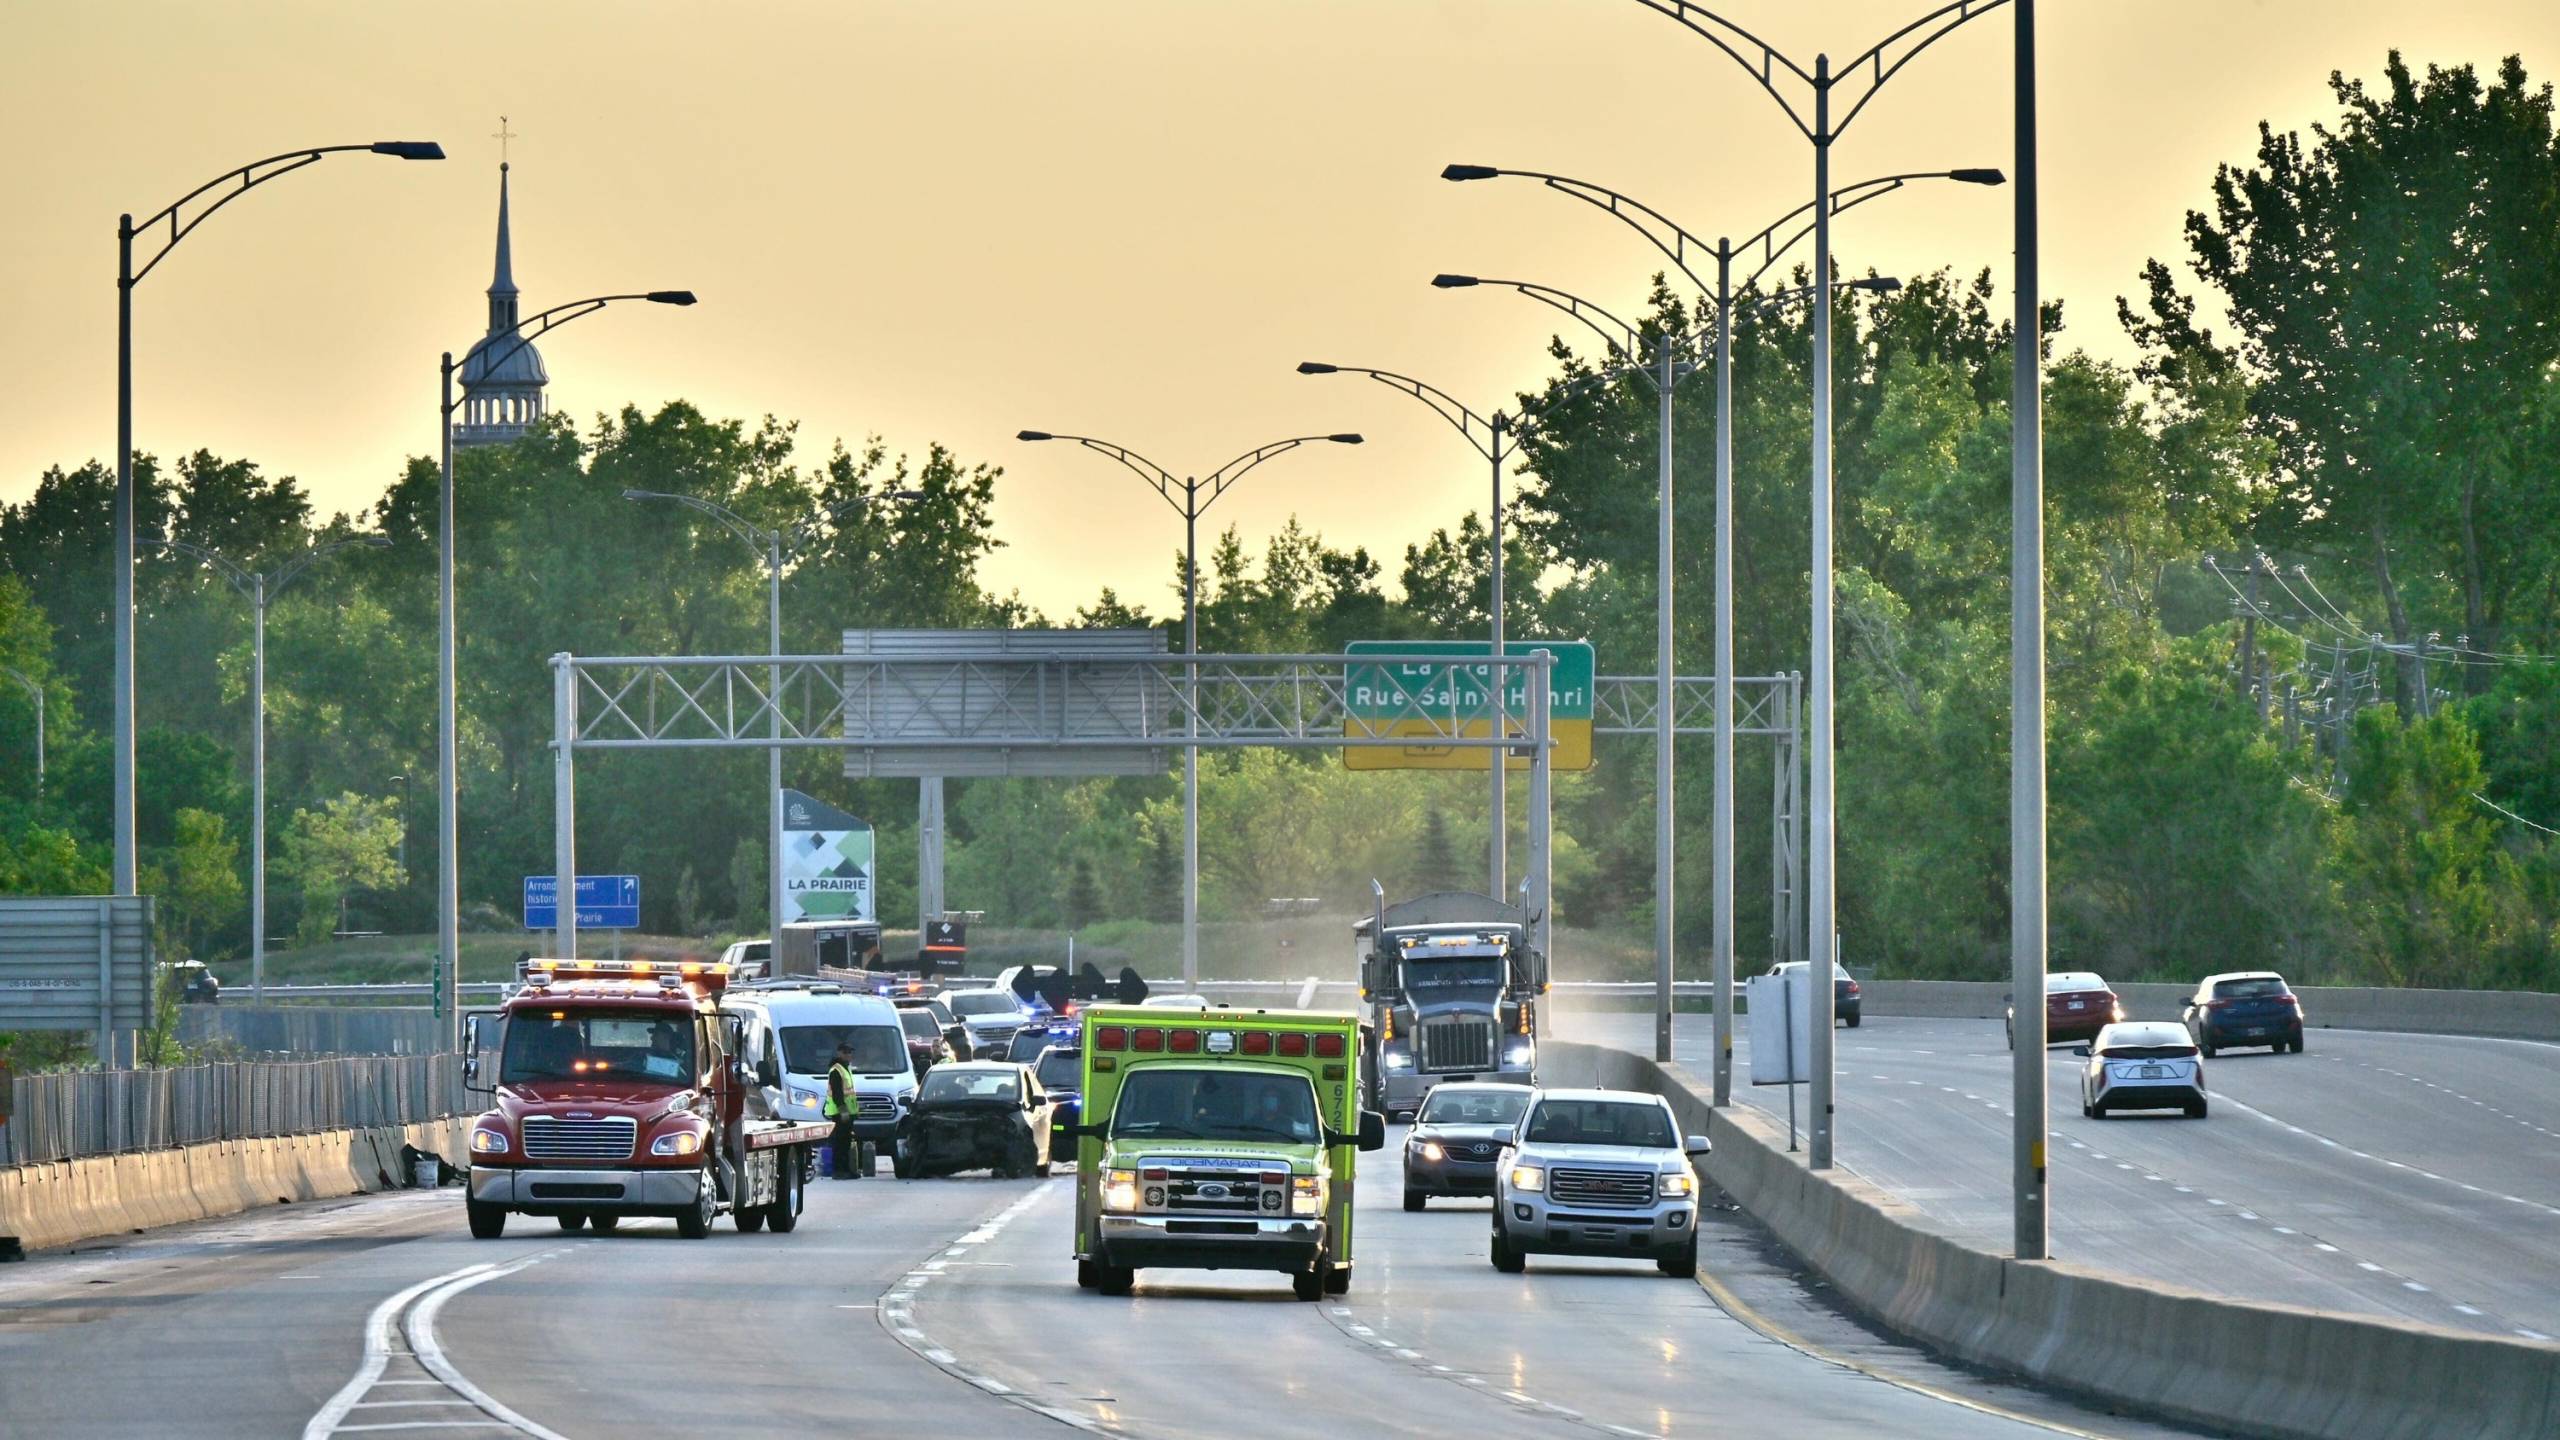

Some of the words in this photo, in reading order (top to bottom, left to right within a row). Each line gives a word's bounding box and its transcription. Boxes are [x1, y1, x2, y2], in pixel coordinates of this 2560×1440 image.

[1356, 686, 1404, 706] Rue
[1511, 687, 1582, 706] Hnri
[788, 879, 806, 889] LA
[811, 879, 866, 889] PRAIRIE
